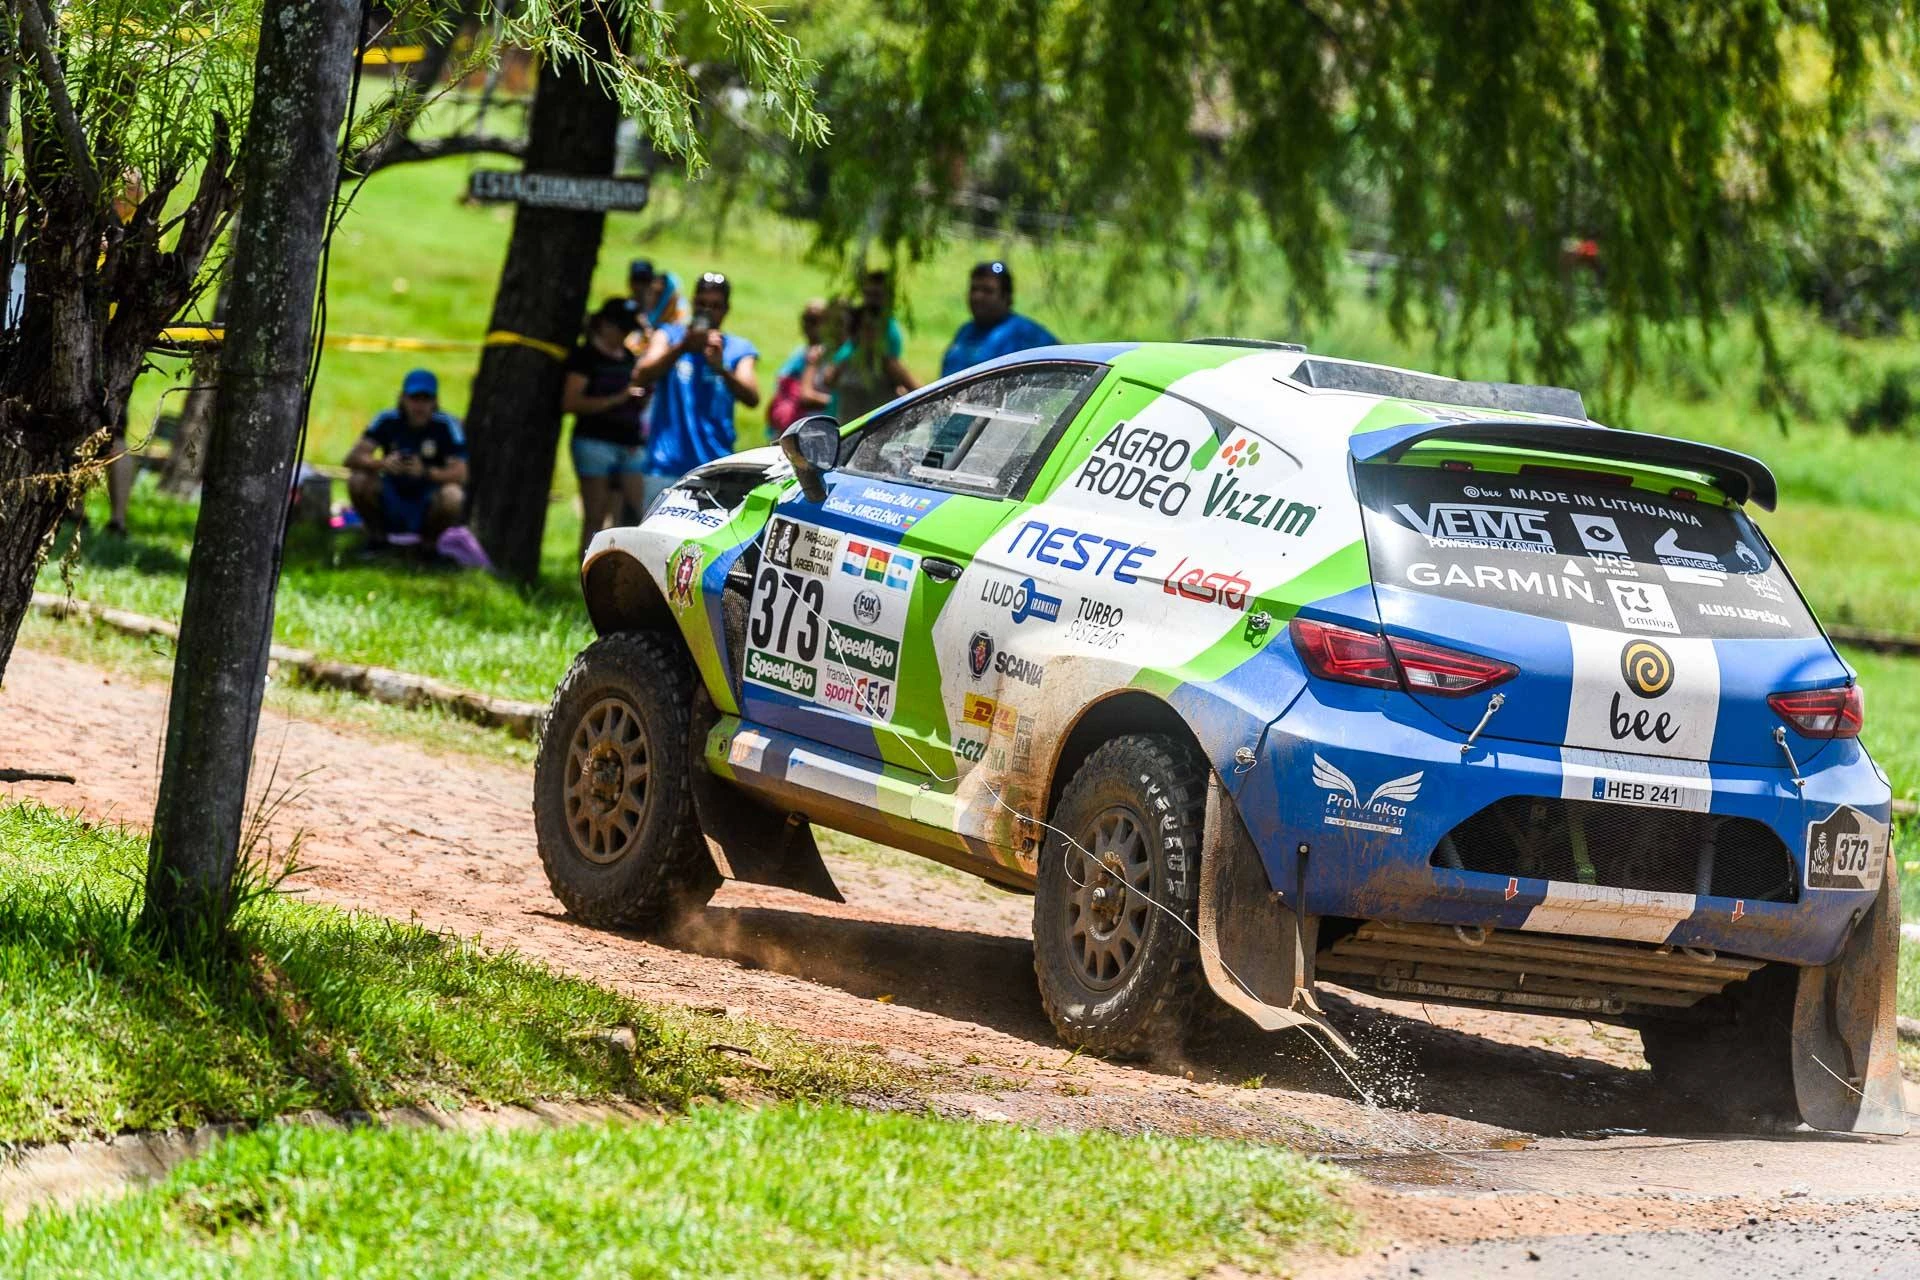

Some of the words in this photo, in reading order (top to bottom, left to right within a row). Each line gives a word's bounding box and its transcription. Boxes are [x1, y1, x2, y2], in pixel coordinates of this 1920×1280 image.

[1095, 422, 1191, 472] AGRO
[1075, 456, 1192, 516] RODEO
[1481, 487, 1502, 497] bee
[1509, 488, 1568, 504] MADE
[1573, 494, 1596, 507] IN
[1599, 497, 1702, 528] LITHUANIA
[804, 530, 838, 549] PARAGUAY
[1392, 503, 1554, 546] VEMS
[1007, 521, 1157, 584] NESTE
[1428, 537, 1489, 549] POWERED
[1489, 540, 1507, 550] BY
[1507, 541, 1557, 555] KAMUTO
[1587, 551, 1635, 569] VRS
[794, 557, 829, 577] ARGENTINA
[1659, 555, 1728, 572] adFINGERS
[981, 579, 1026, 611] LIUDO
[1406, 562, 1595, 605] GARMIN
[752, 567, 824, 662] 373
[860, 595, 876, 613] FOX
[1078, 597, 1123, 628] TURBO
[1628, 617, 1674, 629] omniva
[829, 628, 894, 669] SpeedAgro
[749, 653, 813, 691] SpeedAgro
[994, 651, 1044, 688] SCANIA
[825, 682, 854, 704] sport
[1609, 691, 1681, 744] bee
[1607, 781, 1645, 800] HEB
[1650, 786, 1678, 804] 241
[1838, 839, 1869, 871] 373
